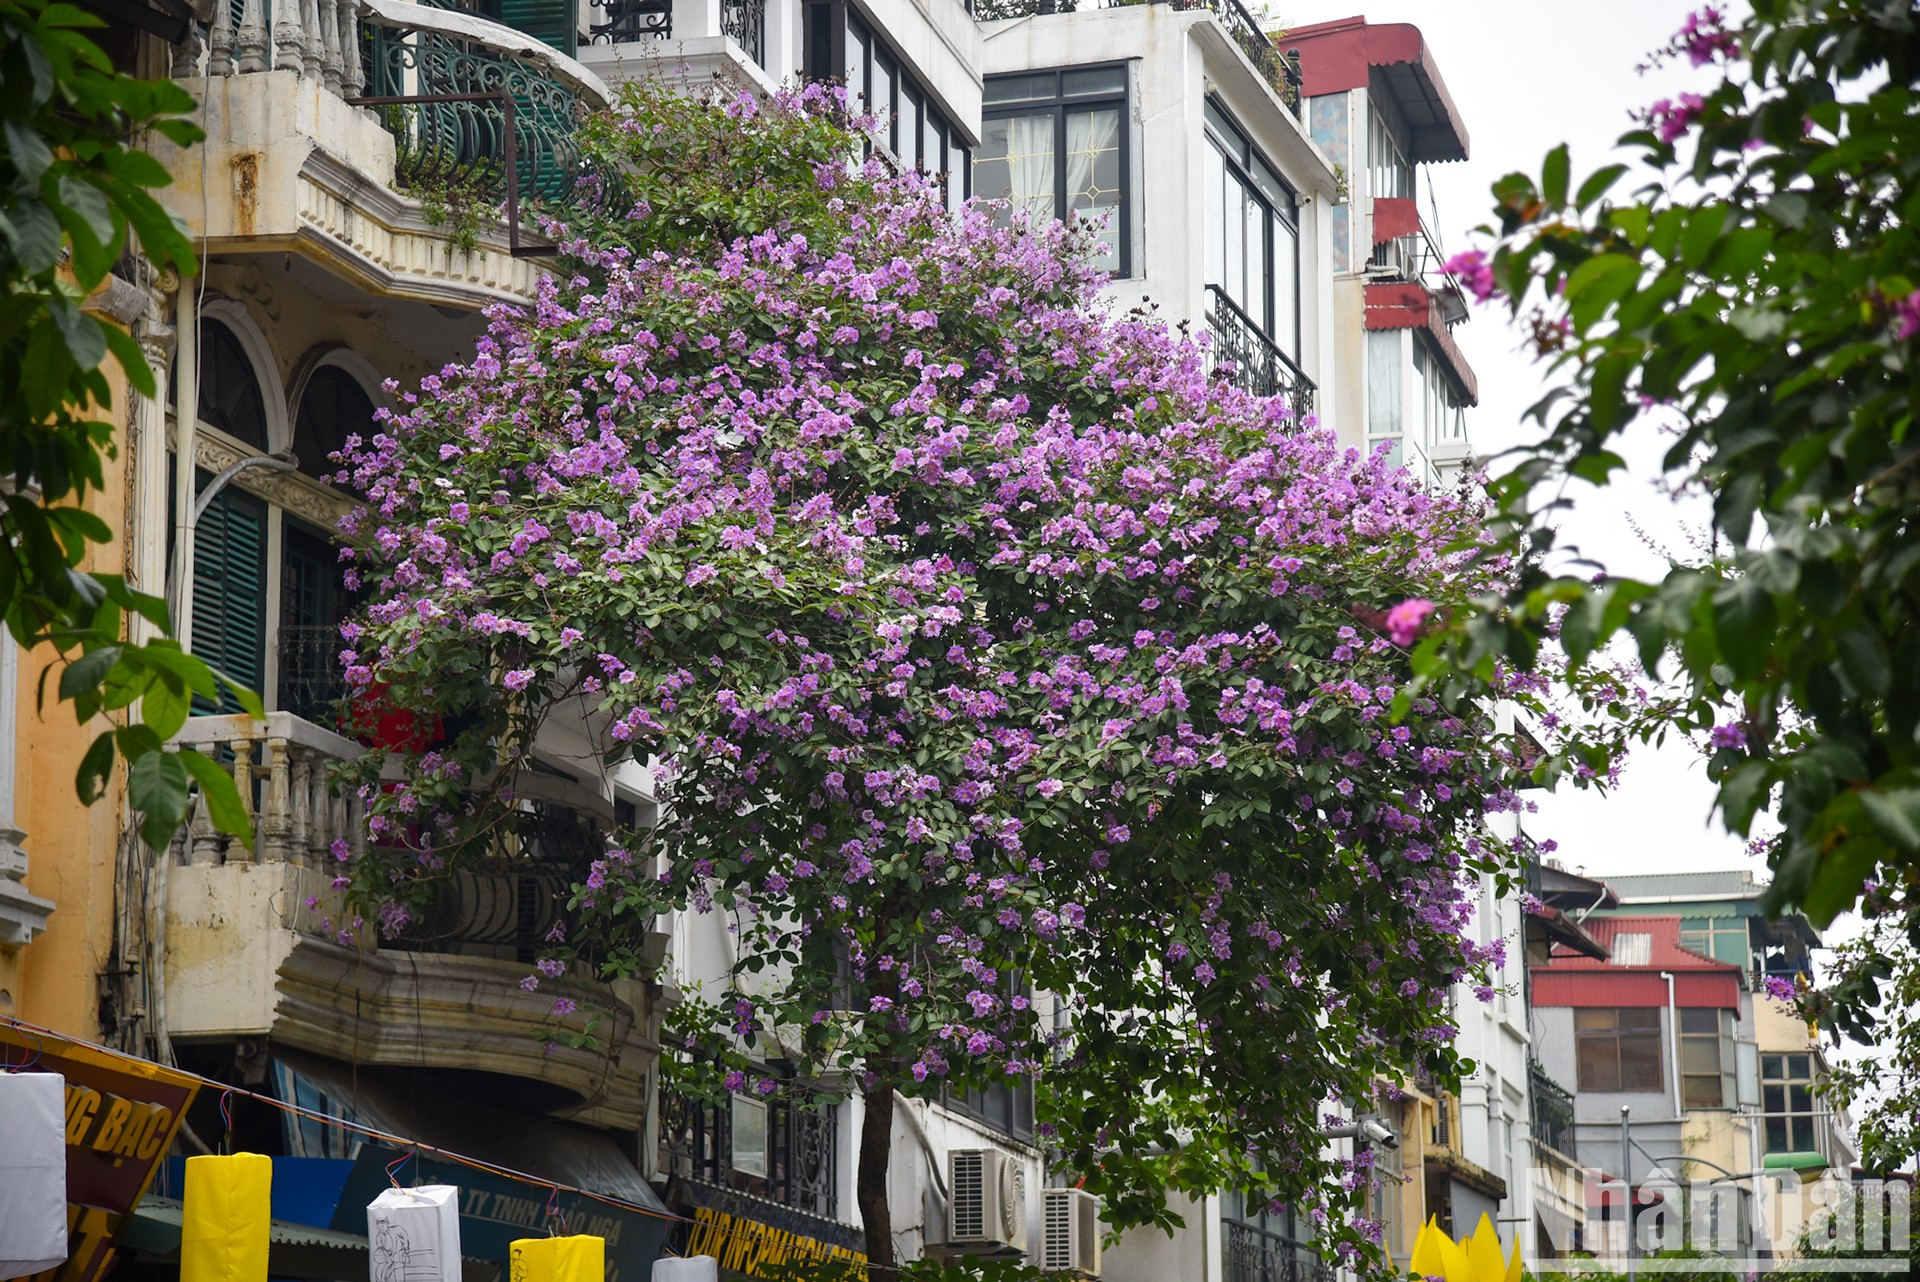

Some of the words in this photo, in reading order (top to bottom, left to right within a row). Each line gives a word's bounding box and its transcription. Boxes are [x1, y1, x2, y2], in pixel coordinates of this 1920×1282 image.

[93, 1098, 172, 1168] BẠC
[464, 1189, 490, 1216] TY
[490, 1195, 541, 1227] TNHH
[687, 1206, 731, 1264] TOUR
